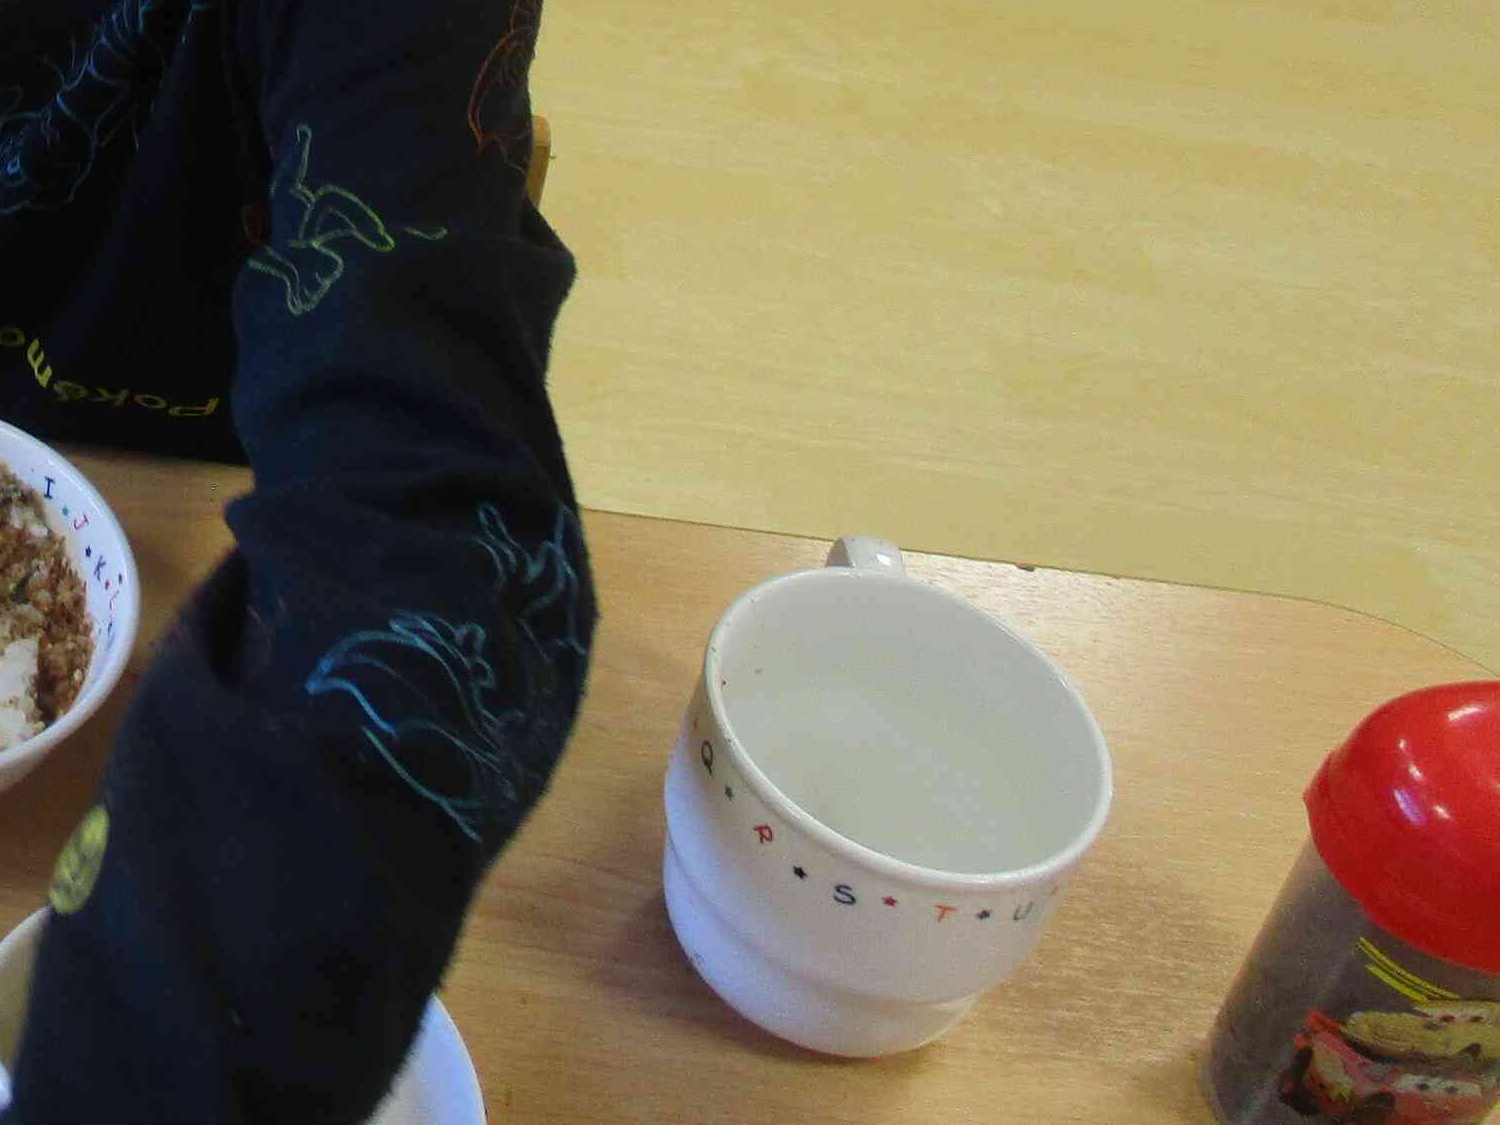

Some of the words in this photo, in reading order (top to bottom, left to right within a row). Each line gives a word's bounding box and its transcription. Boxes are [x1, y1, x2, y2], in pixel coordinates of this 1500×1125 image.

[43, 475, 56, 500] I
[701, 740, 714, 776] Q
[754, 824, 773, 844] R
[833, 883, 857, 906] S
[934, 905, 957, 923] T
